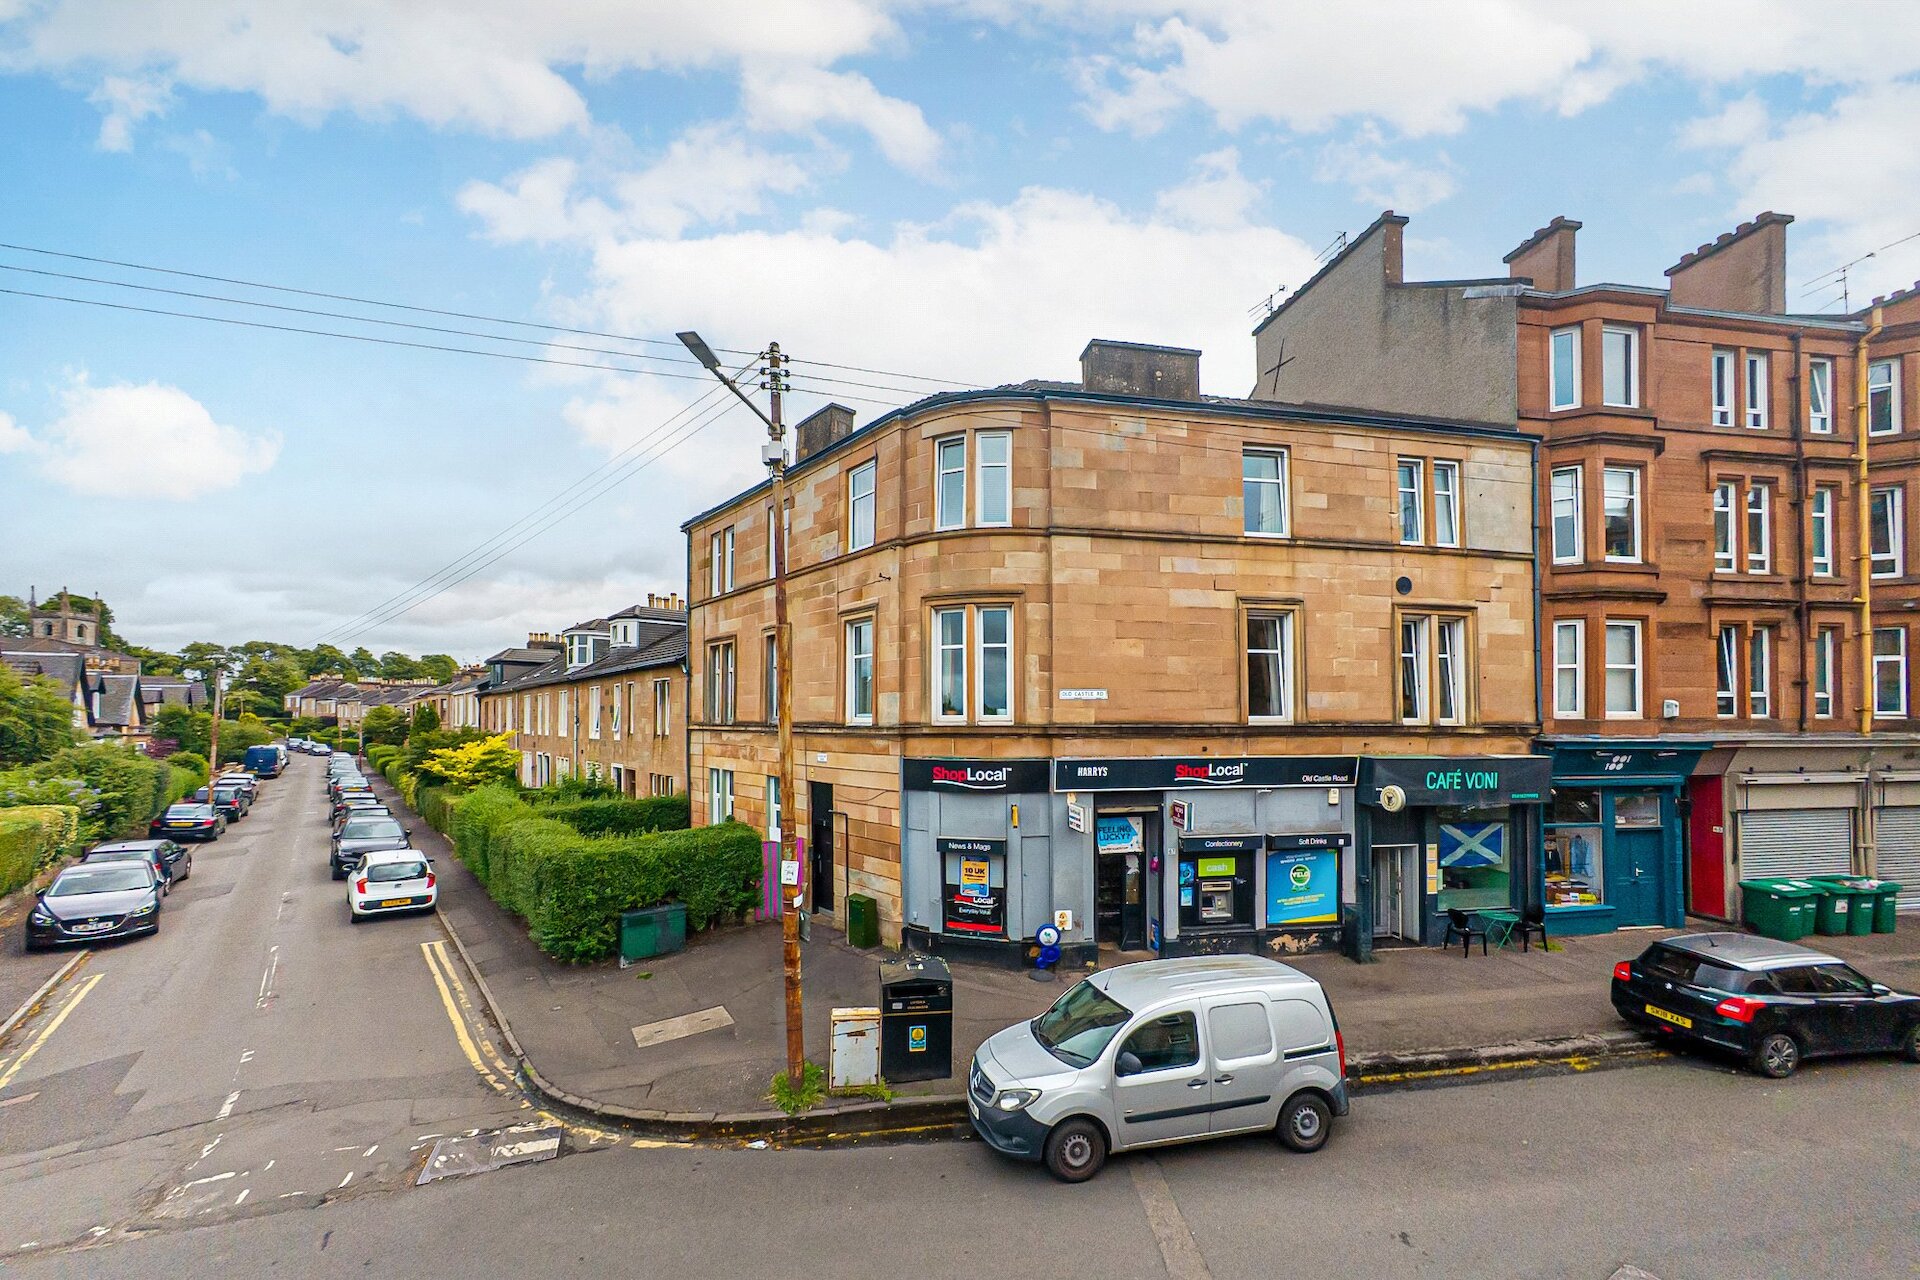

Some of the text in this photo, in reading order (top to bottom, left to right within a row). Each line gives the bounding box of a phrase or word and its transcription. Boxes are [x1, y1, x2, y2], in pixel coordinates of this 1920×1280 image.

[1301, 774, 1349, 783] Old Castle Road
[1426, 768, 1498, 790] CAFÉ VONI
[1099, 825, 1132, 834] FEELING
[1099, 833, 1131, 841] LUCKY?
[1310, 837, 1327, 845] Drinks
[948, 842, 966, 850] News
[973, 843, 991, 852] Mags
[1205, 840, 1244, 848] Confectionery
[1207, 863, 1228, 872] cash
[958, 907, 979, 915] Everyday
